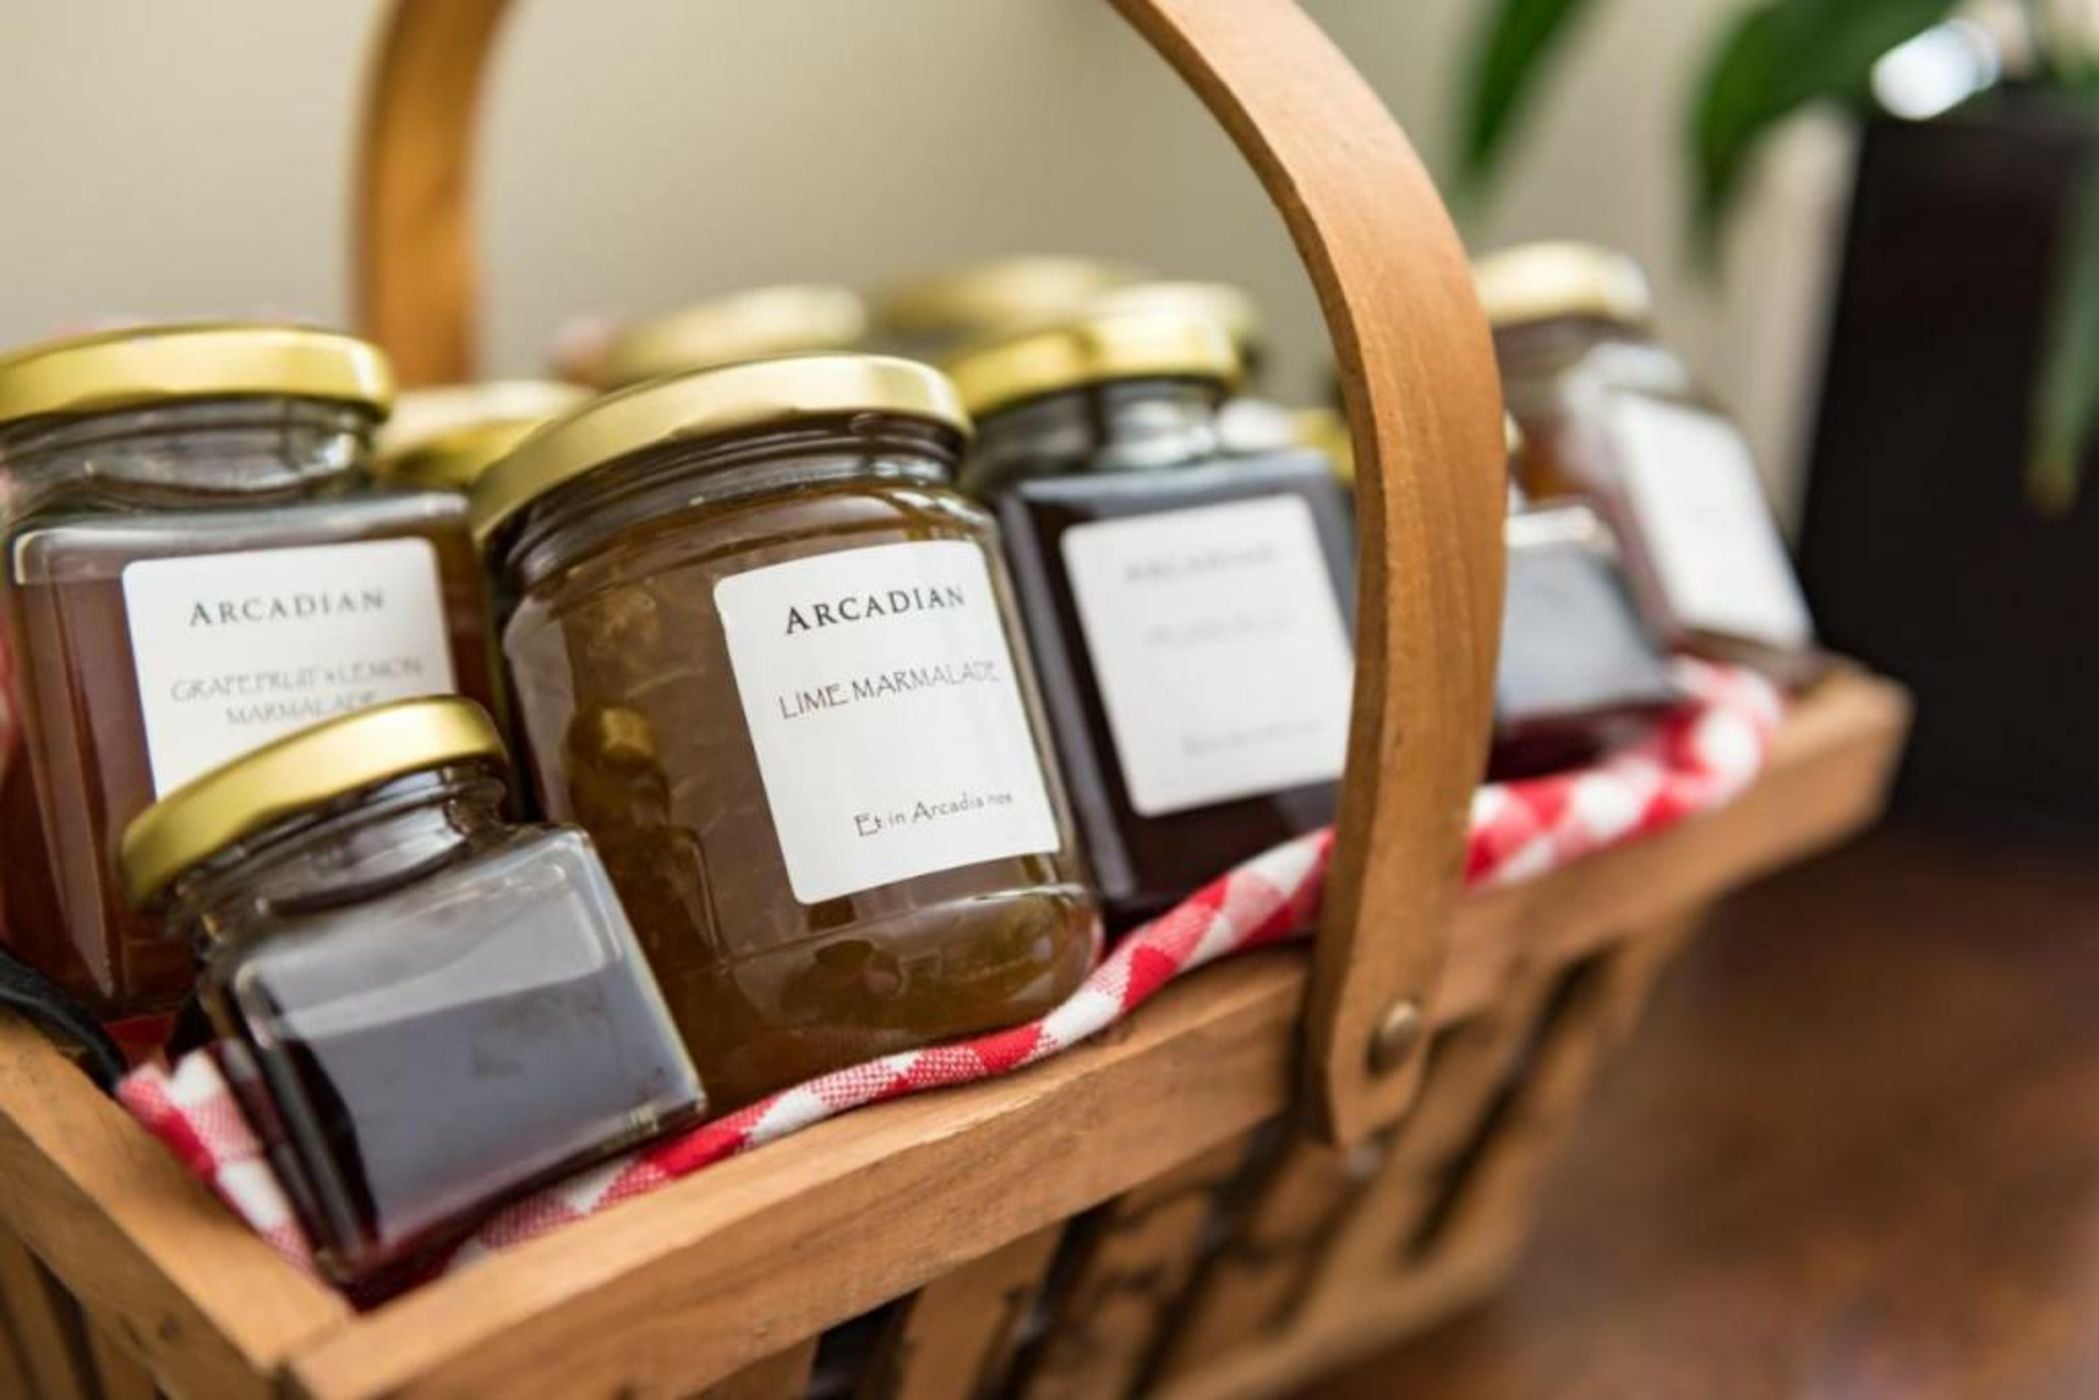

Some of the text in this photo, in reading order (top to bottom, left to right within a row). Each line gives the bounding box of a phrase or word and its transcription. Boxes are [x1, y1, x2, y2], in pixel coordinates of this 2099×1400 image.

[190, 587, 385, 627] ARCADIAN
[785, 586, 966, 634] ARCADIAN
[170, 665, 318, 702] GRAPEFRUIT
[777, 661, 1000, 720] LIME MARMALADE
[854, 811, 883, 837] Et
[888, 807, 907, 828] in
[911, 790, 985, 822] Arcadia
